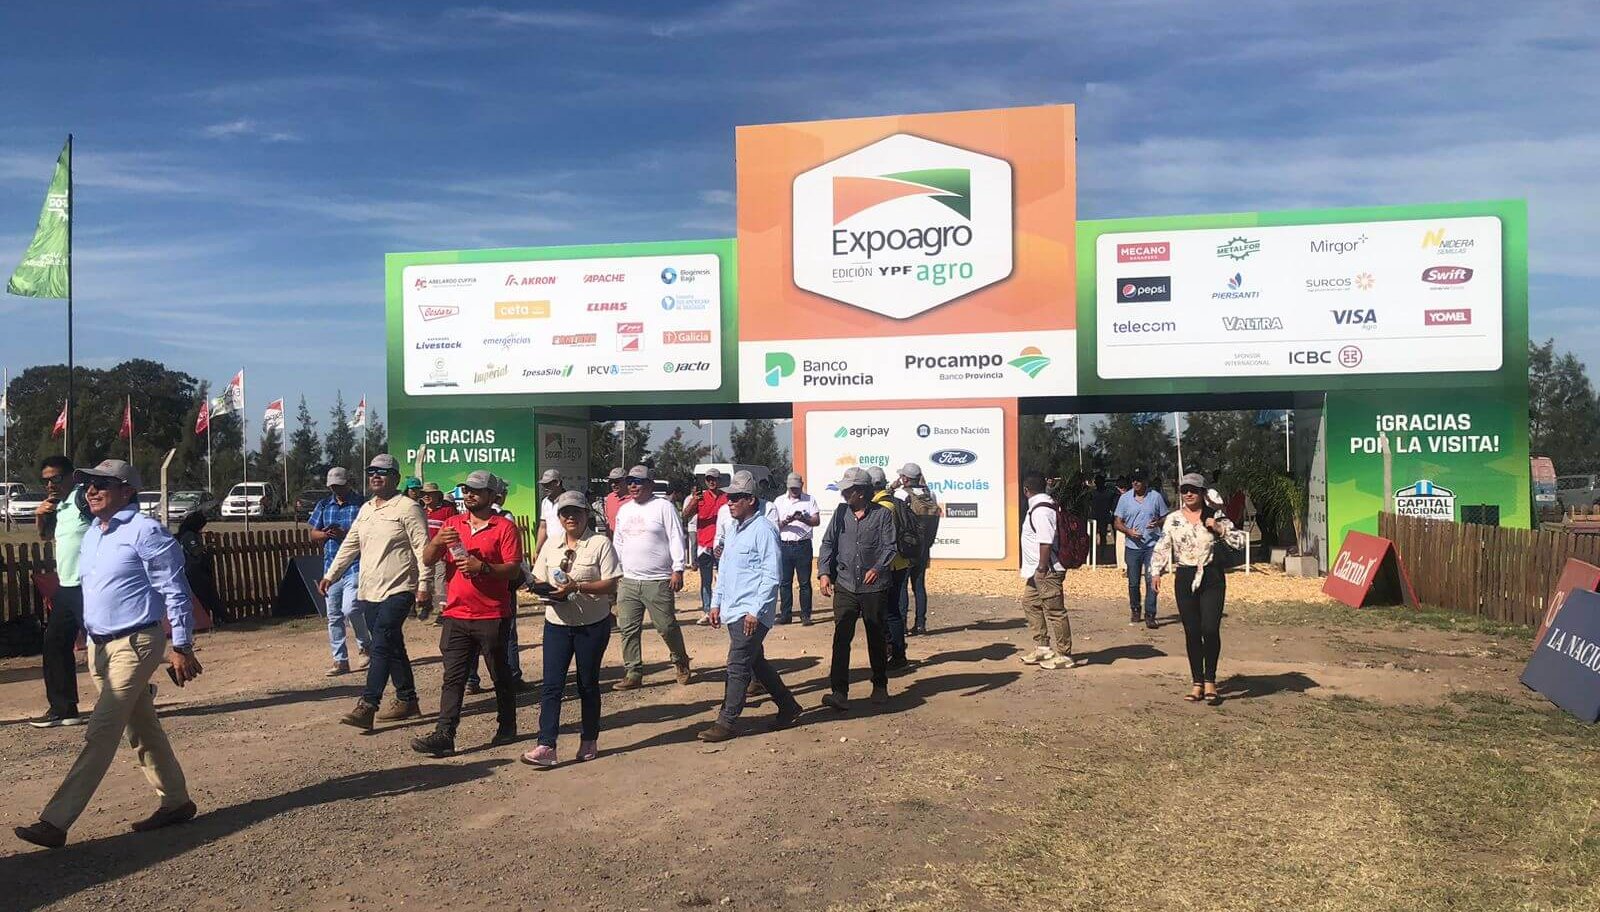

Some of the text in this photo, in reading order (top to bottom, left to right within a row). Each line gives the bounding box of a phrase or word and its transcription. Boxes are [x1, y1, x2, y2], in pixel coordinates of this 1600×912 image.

[833, 225, 973, 259] Expoagro
[1310, 239, 1358, 255] Mirgor
[1439, 239, 1474, 248] NIDERA
[1120, 246, 1166, 256] MECANO
[1216, 243, 1260, 255] METALFOR
[583, 274, 625, 284] APACHE
[832, 261, 973, 285] EDICIÓN YPF agro
[1428, 268, 1467, 281] Swift
[521, 275, 556, 286] AKRON
[1305, 278, 1352, 288] SURCOS
[1137, 284, 1167, 296] pepsi
[587, 302, 628, 312] CLAAS
[1330, 308, 1377, 325] VISA
[1428, 311, 1467, 322] YOMEL
[1112, 319, 1176, 334] telecom
[1222, 316, 1283, 331] VALTRA
[678, 332, 709, 342] Galicia
[416, 341, 462, 350] Livestock
[904, 352, 1003, 371] Procampo
[1288, 350, 1331, 365] ICBC
[587, 364, 619, 376] IPCVA
[674, 360, 711, 373] jacto
[803, 359, 848, 372] Banco
[803, 373, 874, 387] Provincia
[939, 371, 1004, 381] Banco Provincia
[1376, 413, 1471, 432] ¡GRACIAS
[426, 429, 495, 444] ¡GRACIAS
[849, 425, 890, 438] agripay
[933, 425, 991, 435] Banco Nación
[1396, 436, 1422, 453] LA
[1429, 435, 1499, 453] VISITA!
[407, 448, 516, 463] PR LA VISITA!
[859, 453, 890, 467] energy
[938, 451, 968, 465] Ford
[927, 479, 990, 494] an Nicolás
[1397, 499, 1452, 508] CAPITAL
[946, 506, 977, 518] Ternium
[1398, 507, 1452, 515] NACIONAL
[1546, 628, 1600, 674] LA NACIO
